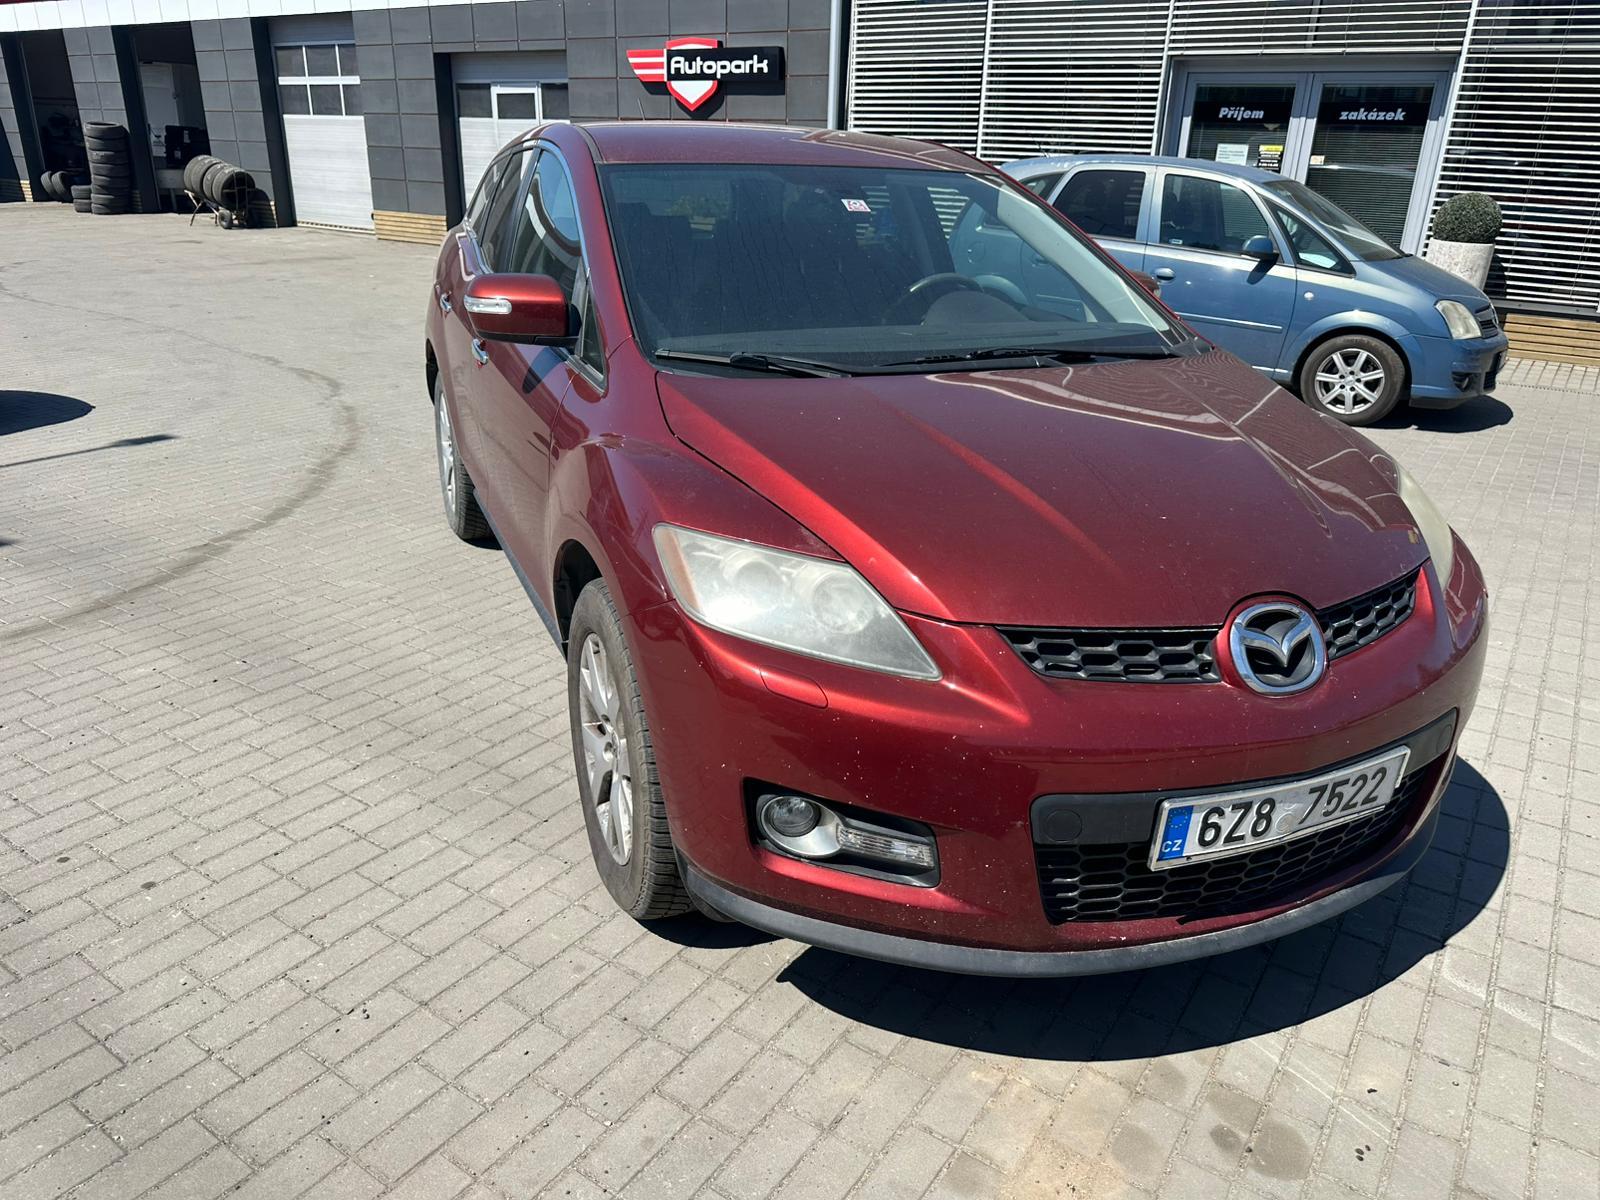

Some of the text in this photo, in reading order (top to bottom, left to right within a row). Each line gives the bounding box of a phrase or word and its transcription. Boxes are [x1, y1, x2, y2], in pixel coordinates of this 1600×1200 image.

[671, 55, 768, 79] Autopark
[1219, 107, 1406, 121] Příjem zakázek
[1197, 767, 1388, 848] 6Z8 7522
[1162, 839, 1181, 853] CZ
